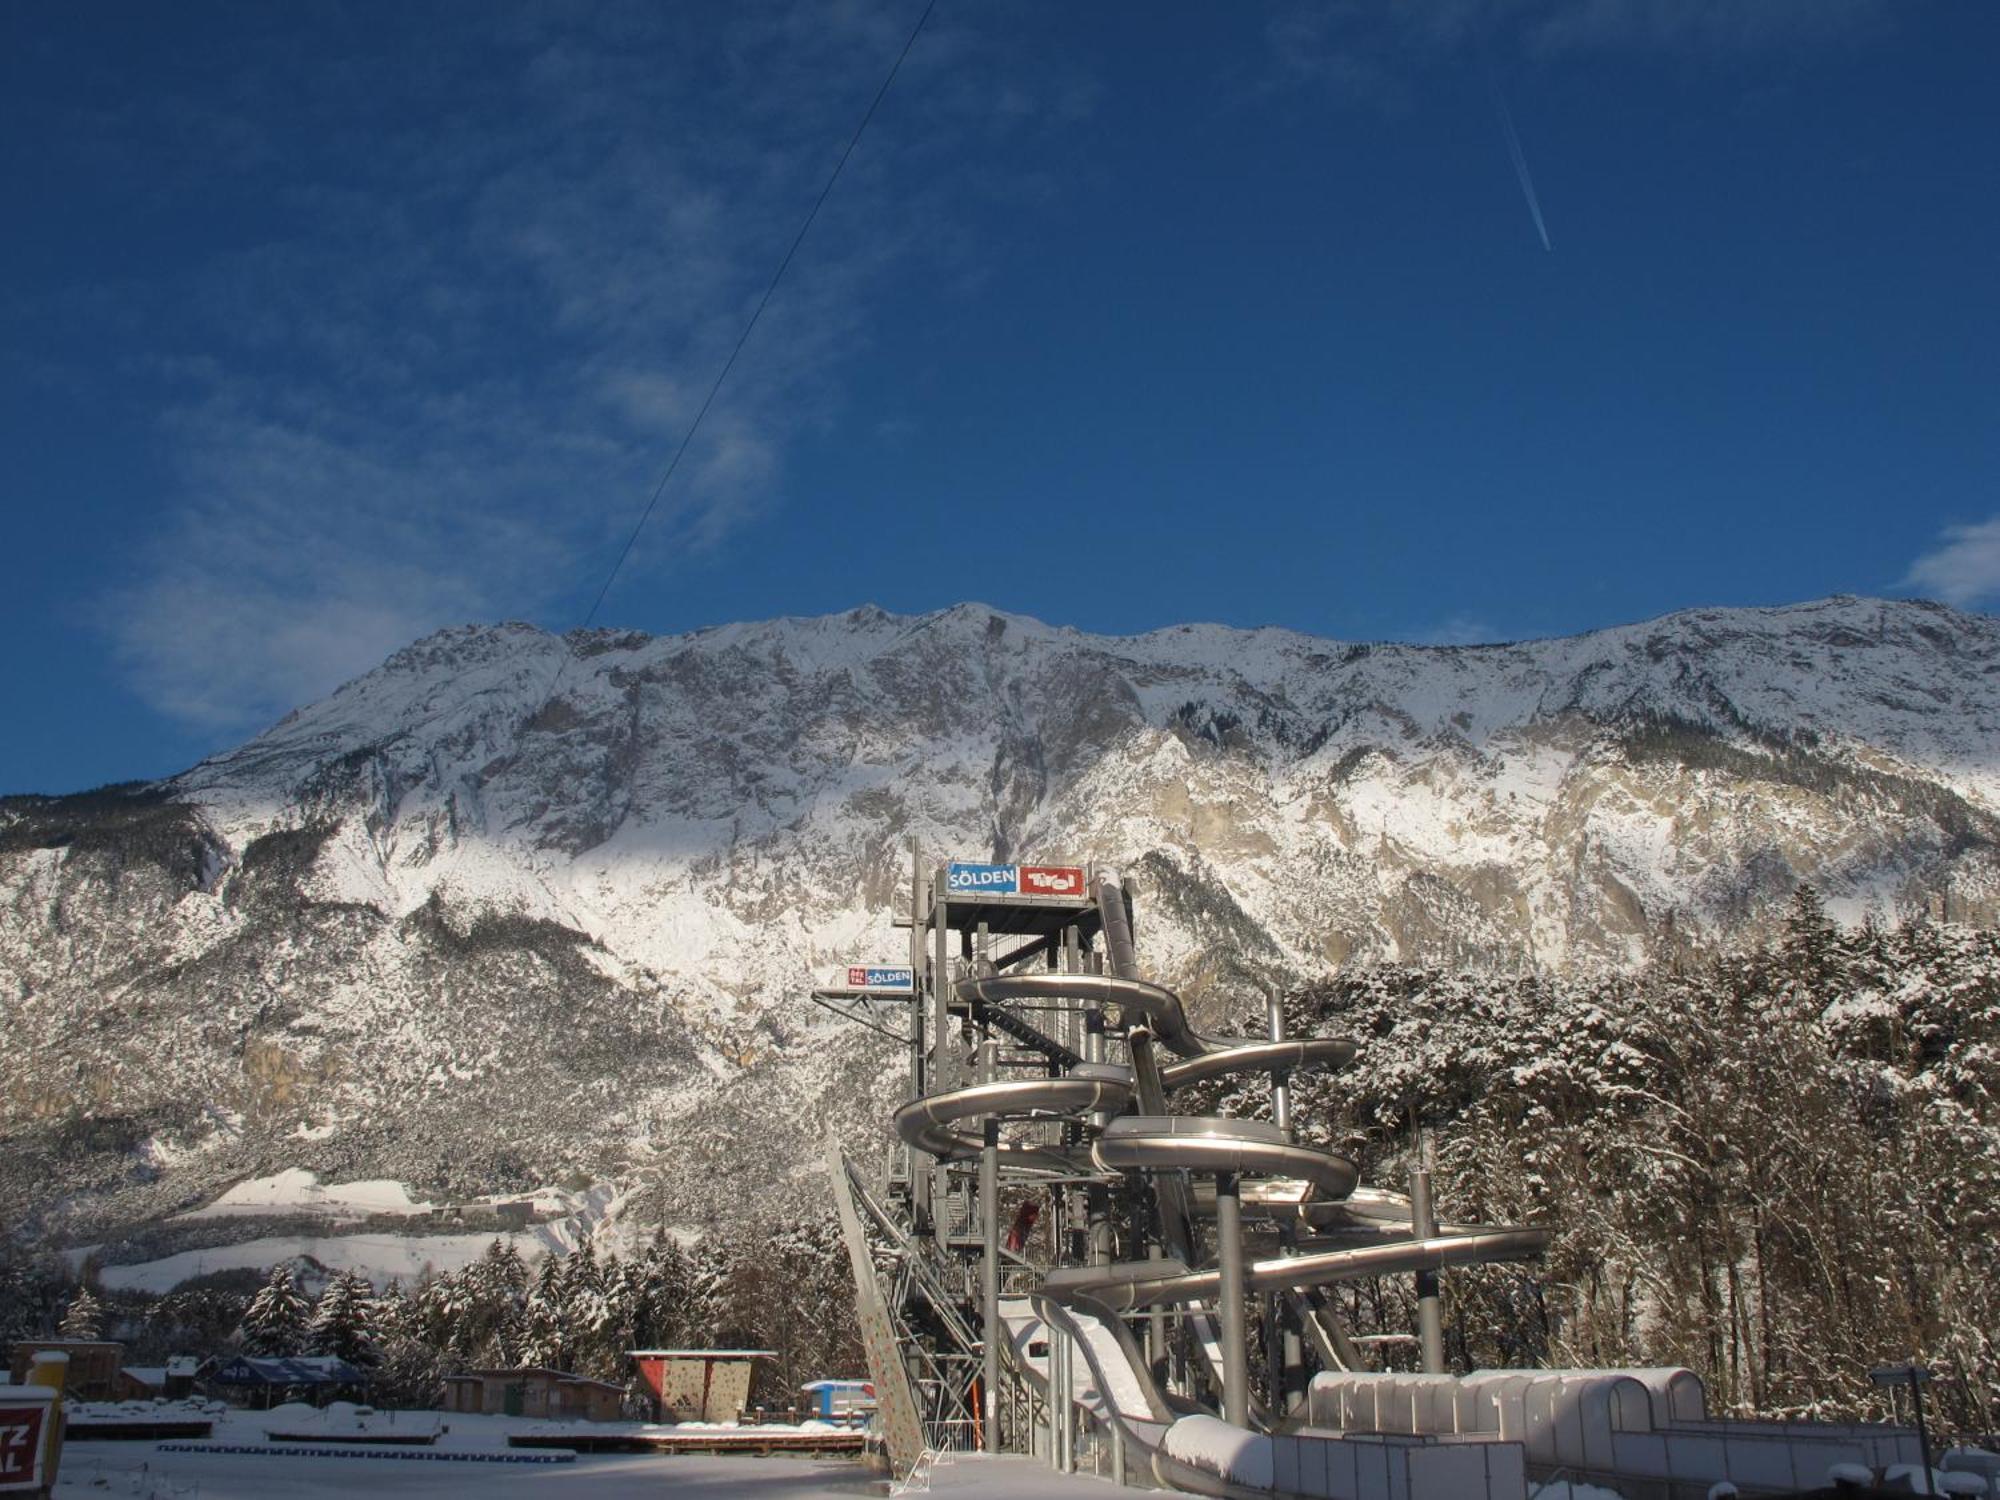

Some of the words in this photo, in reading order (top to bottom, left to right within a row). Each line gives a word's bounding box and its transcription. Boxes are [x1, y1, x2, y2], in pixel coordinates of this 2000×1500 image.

[949, 870, 1014, 887] SÖLDEN
[1028, 873, 1075, 890] Tirol
[867, 971, 910, 984] SÖLDEN
[0, 1452, 22, 1472] L
